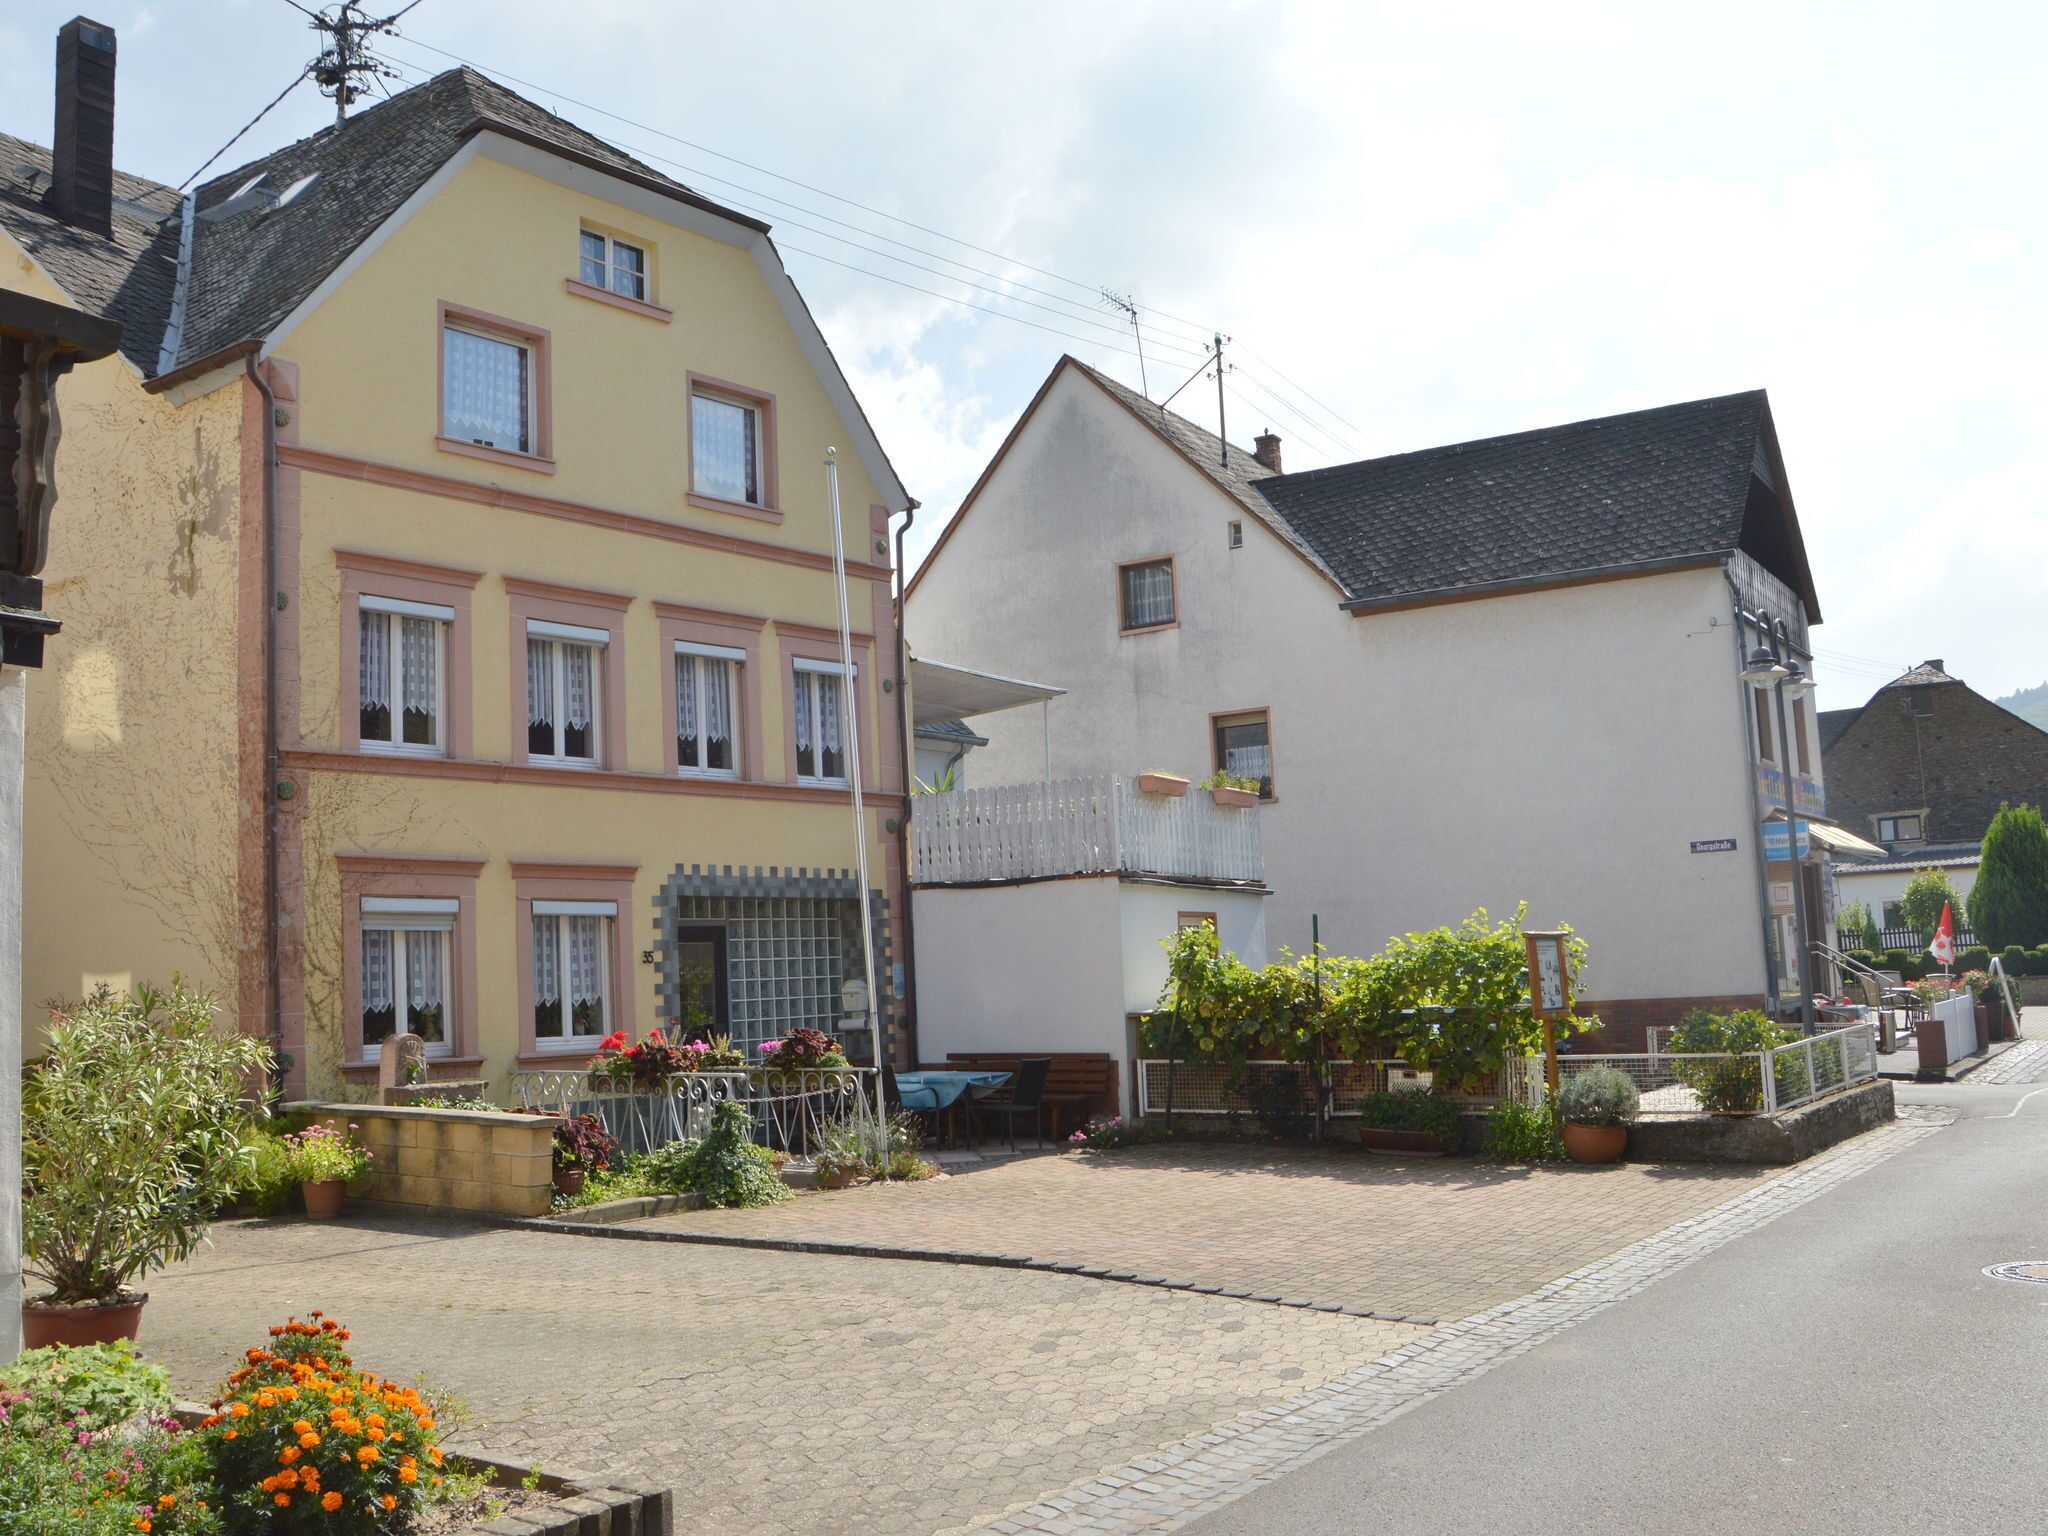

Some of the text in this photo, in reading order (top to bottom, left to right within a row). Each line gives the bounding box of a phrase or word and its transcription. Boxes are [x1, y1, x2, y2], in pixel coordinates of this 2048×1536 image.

[1776, 836, 1806, 845] Heres
[1696, 841, 1731, 851] Georgstraße
[642, 950, 654, 964] 35
